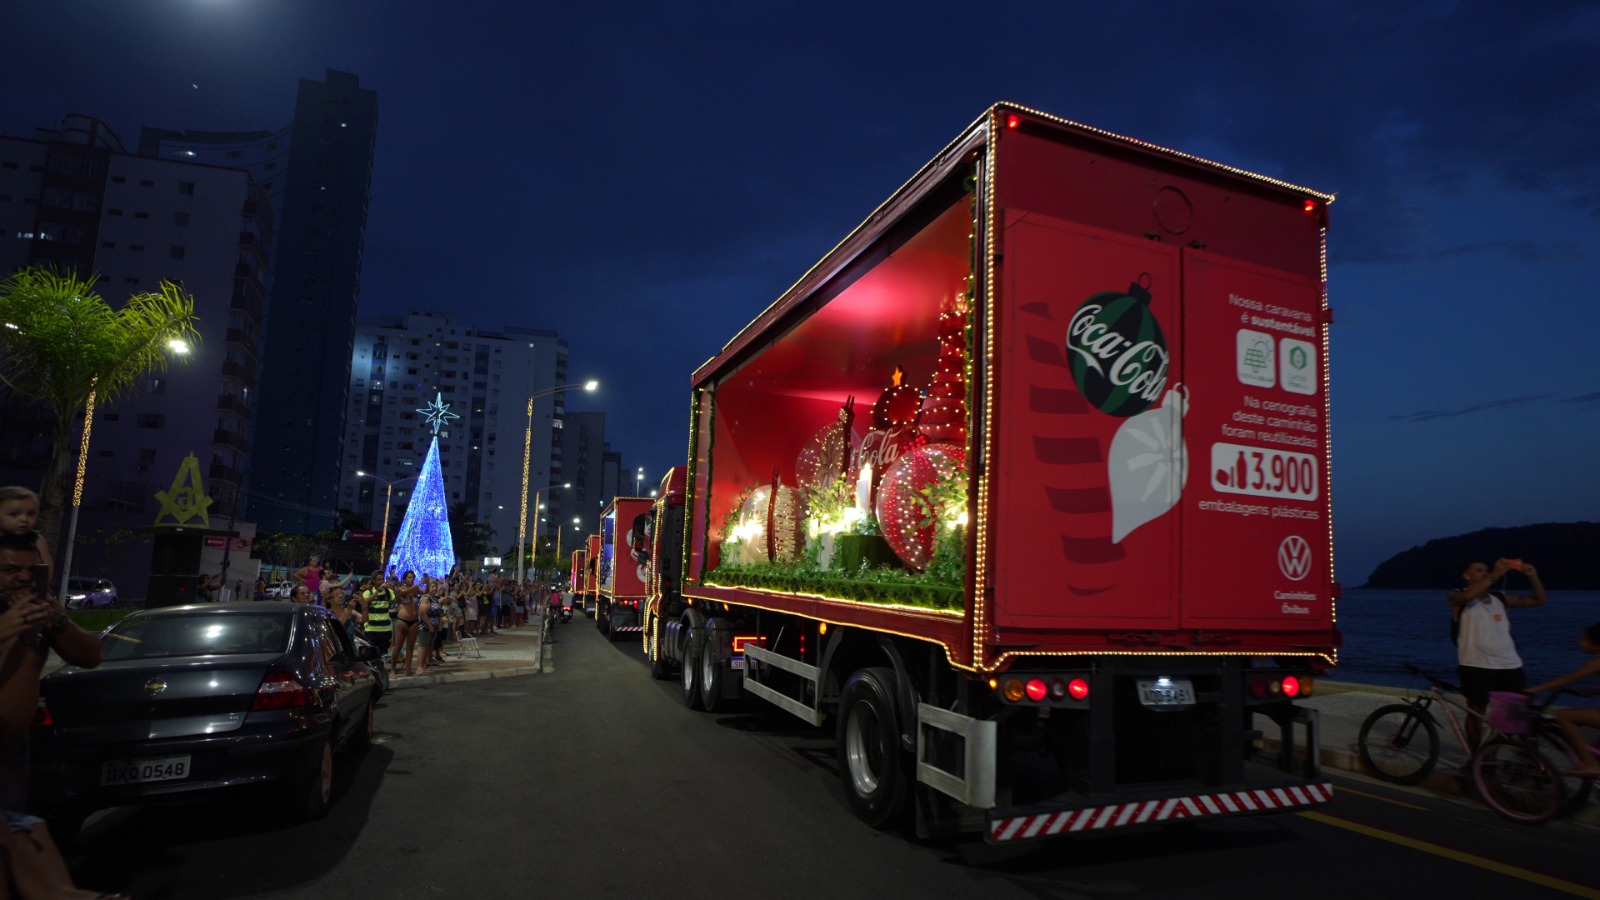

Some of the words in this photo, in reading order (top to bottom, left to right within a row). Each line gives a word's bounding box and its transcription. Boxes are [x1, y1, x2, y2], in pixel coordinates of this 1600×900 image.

[1228, 293, 1263, 312] Nossa
[1265, 304, 1313, 322] caravana
[1241, 311, 1250, 324] é
[1251, 316, 1316, 338] sustentável
[1244, 395, 1260, 409] Na
[1262, 400, 1318, 418] cenografia
[1232, 409, 1265, 425] deste
[1266, 417, 1319, 433] caminhão
[1221, 423, 1256, 440] foram
[1257, 431, 1318, 449] reutilizadas
[1252, 451, 1313, 495] 3.900
[1198, 499, 1270, 516] embalagens
[1271, 504, 1320, 520] plásticas
[1273, 590, 1317, 601] Caminhões
[1281, 601, 1311, 614] Ônibus
